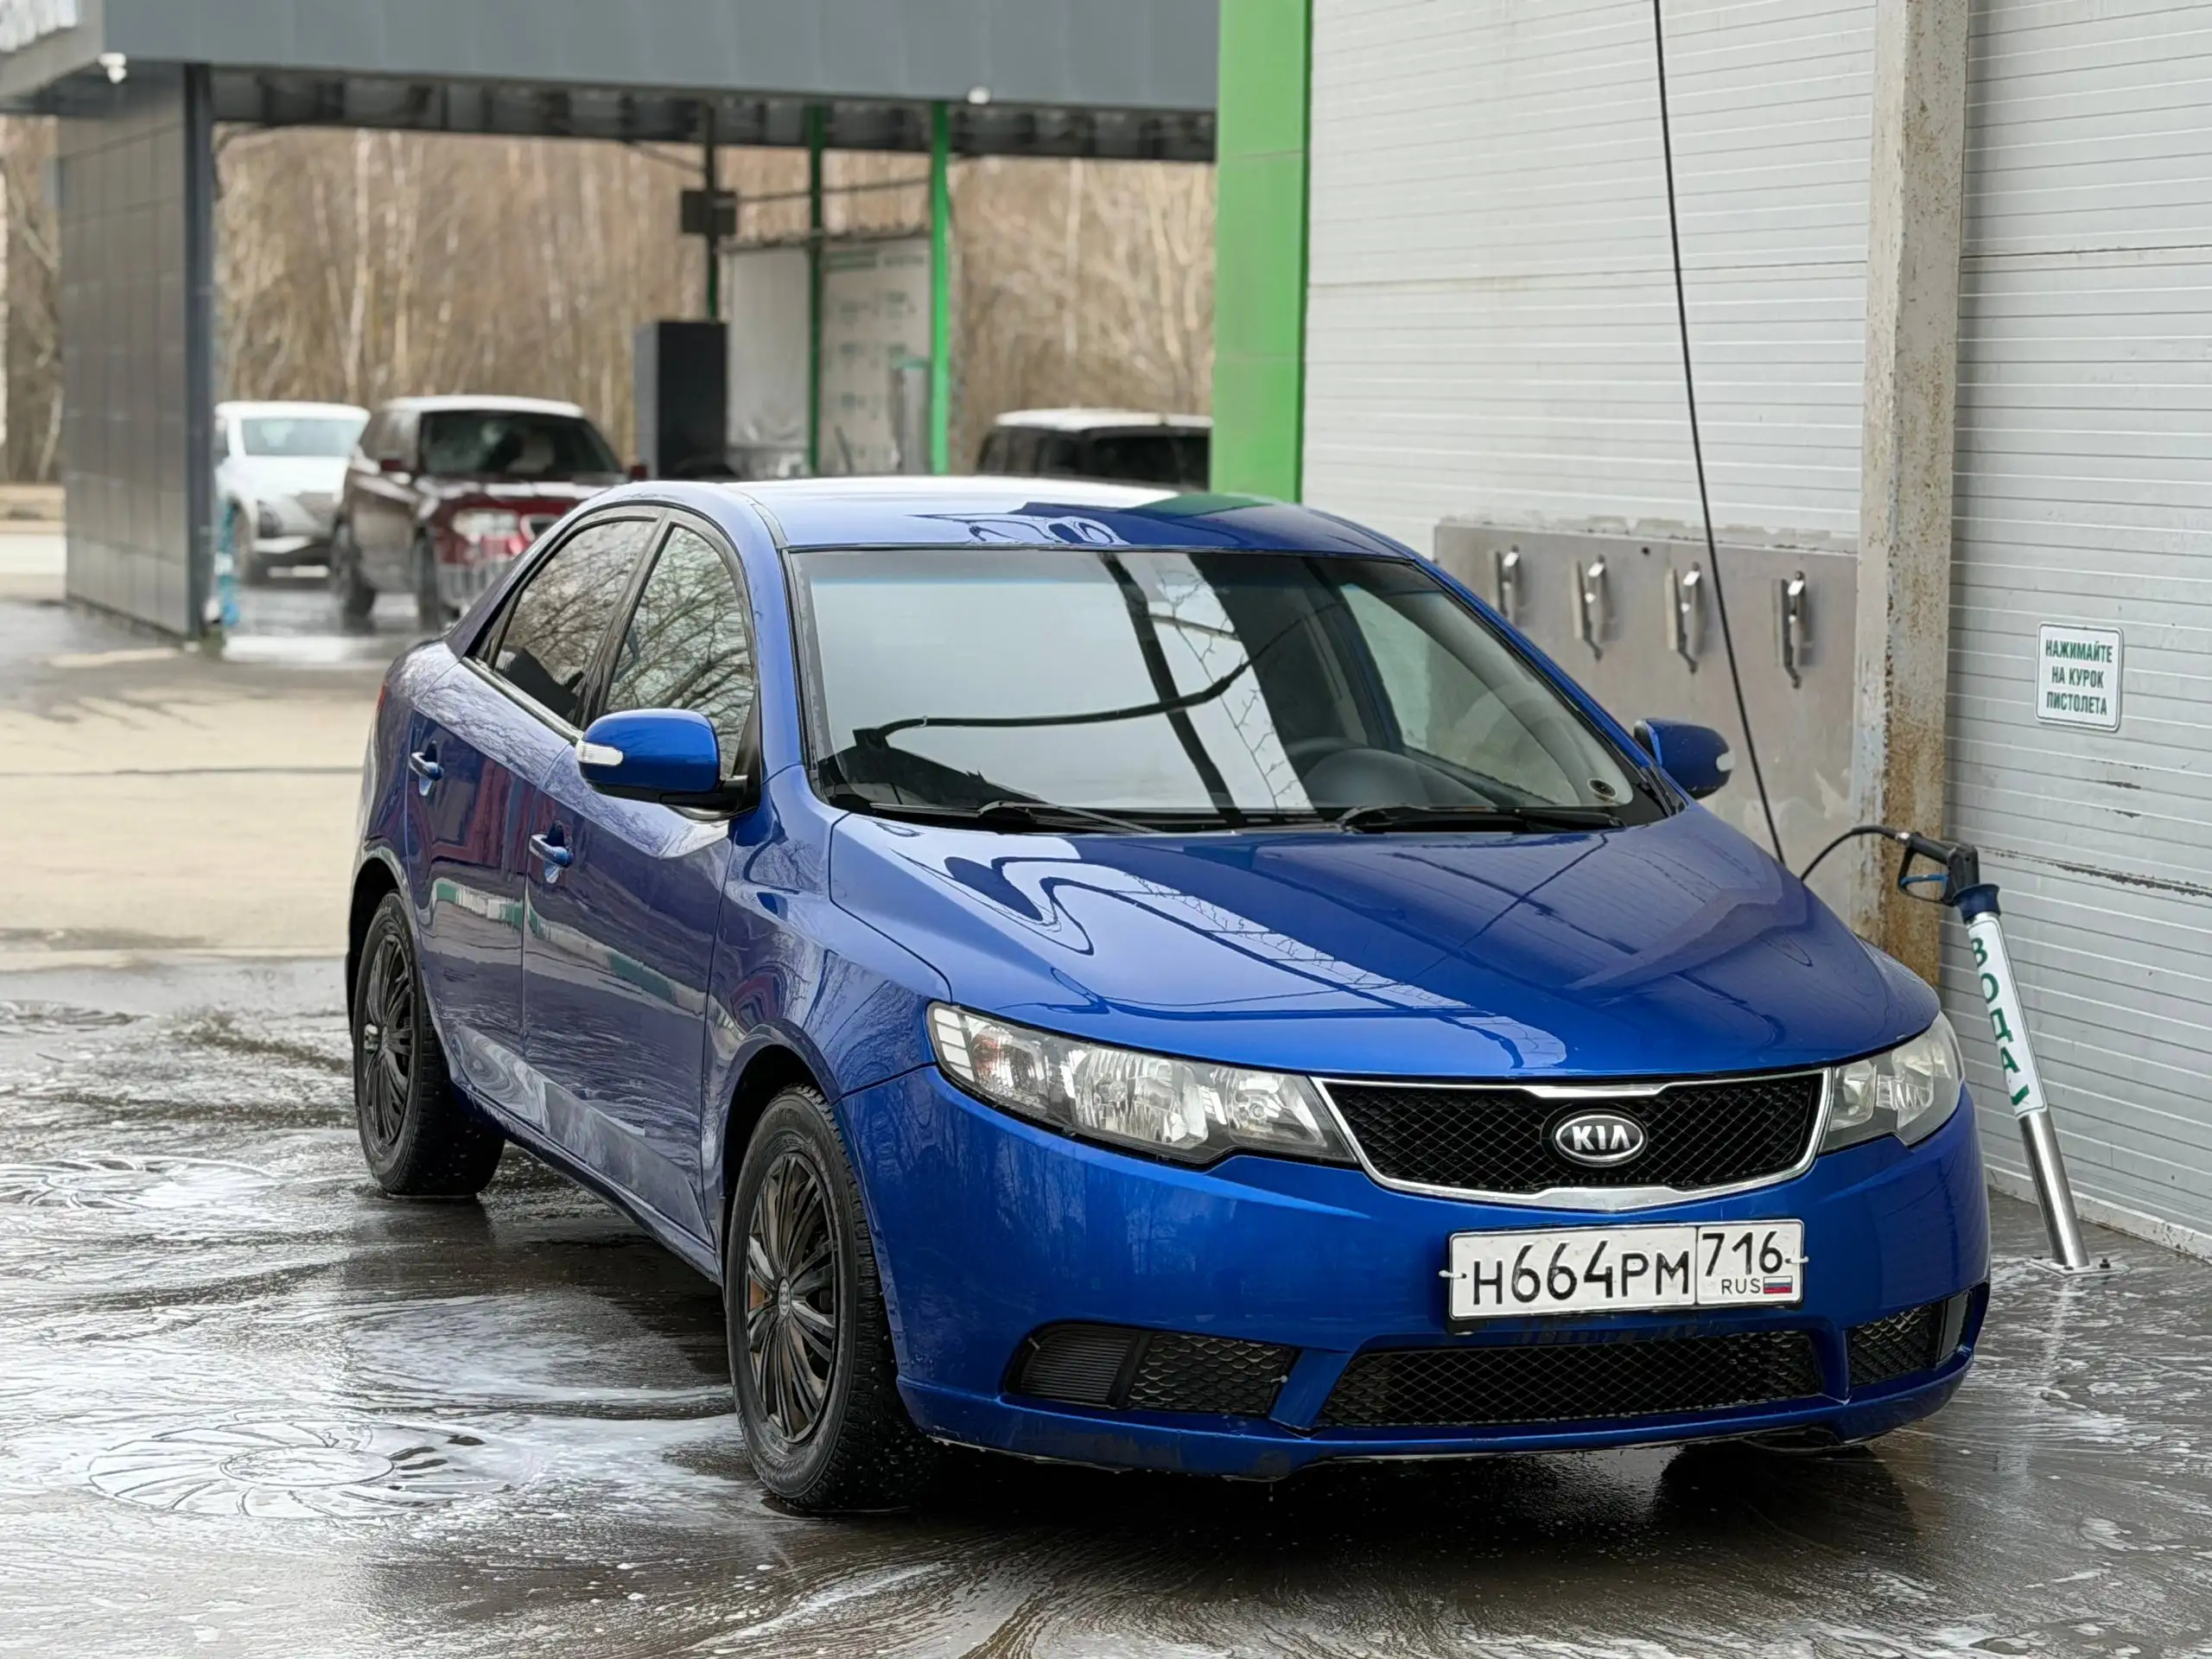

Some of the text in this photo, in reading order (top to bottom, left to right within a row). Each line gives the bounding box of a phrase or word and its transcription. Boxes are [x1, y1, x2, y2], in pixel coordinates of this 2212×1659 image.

[2045, 639, 2113, 663] НАЖИМАЙТЕ
[2051, 665, 2104, 689] НА КУРОК
[2046, 691, 2107, 715] ПИСТОЛЕТА
[1970, 937, 2020, 1074] ВОДА
[1572, 1126, 1631, 1150] KIA
[1701, 1230, 1783, 1276] 716
[1721, 1278, 1761, 1294] RUS
